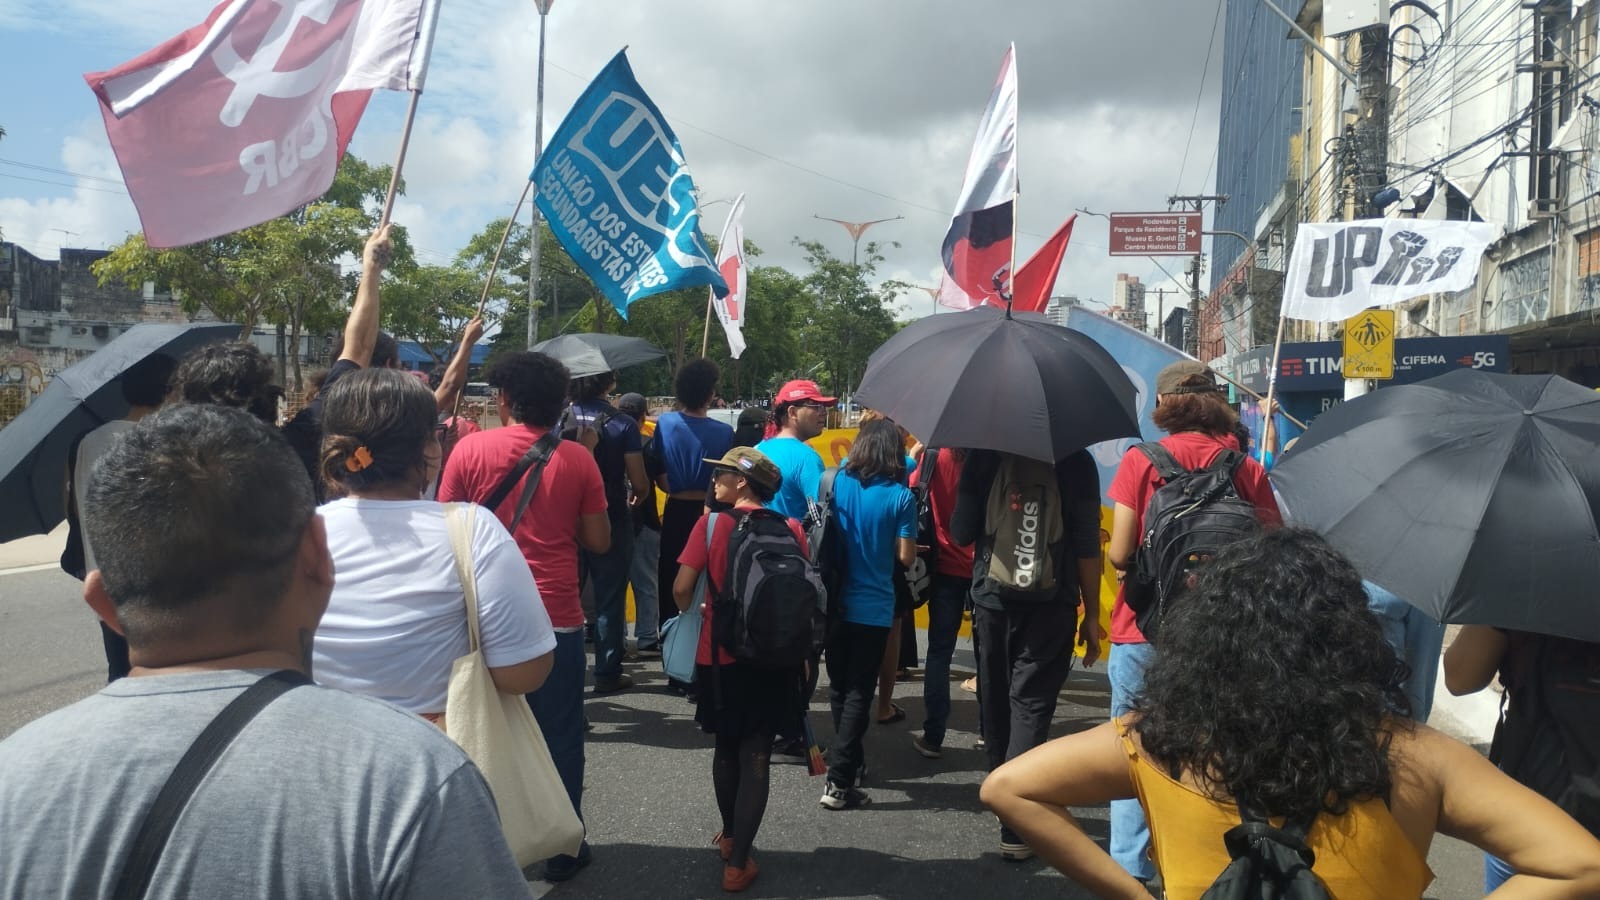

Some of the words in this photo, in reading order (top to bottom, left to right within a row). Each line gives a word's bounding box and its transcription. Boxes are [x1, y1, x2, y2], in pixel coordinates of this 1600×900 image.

[551, 148, 595, 207] UNIÃO
[590, 202, 627, 239] DOS
[540, 166, 632, 282] SECUNDARISTAS
[1114, 226, 1134, 234] Parque
[1305, 226, 1383, 298] UP
[1305, 357, 1343, 375] TIM
[1402, 355, 1446, 365] CIFEMA
[1472, 351, 1496, 369] 5G
[1013, 501, 1039, 588] adidas
